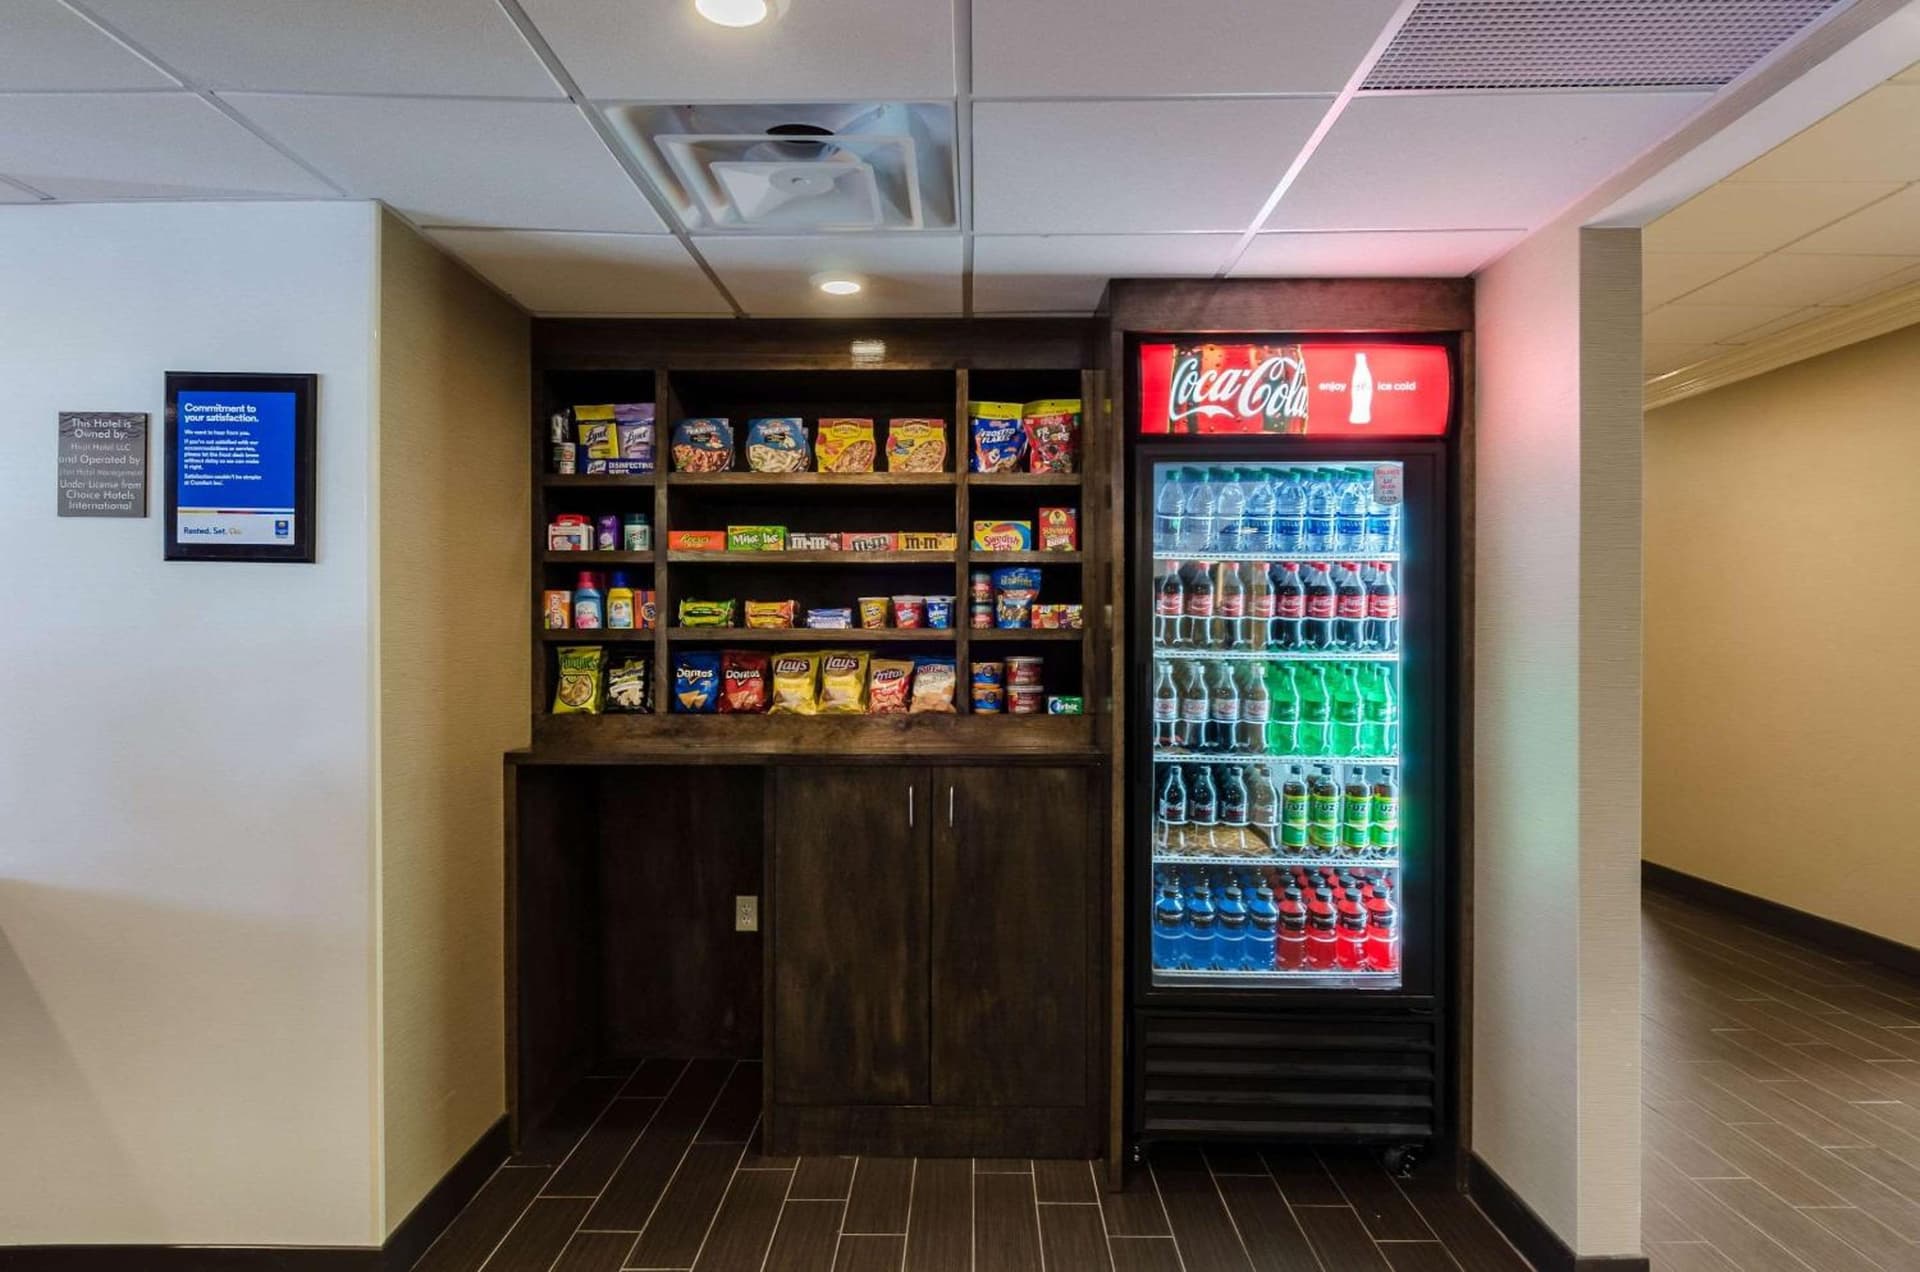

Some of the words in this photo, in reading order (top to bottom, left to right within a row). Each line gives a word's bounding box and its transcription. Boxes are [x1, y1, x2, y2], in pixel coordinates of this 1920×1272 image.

[1319, 382, 1346, 392] enjoy
[1377, 381, 1391, 391] ice
[1393, 381, 1416, 391] cold
[184, 403, 245, 413] Commitment
[247, 404, 257, 413] to
[72, 418, 92, 428] This
[94, 419, 121, 428] Hotel
[123, 420, 132, 428] is
[184, 414, 204, 423] your
[206, 413, 259, 422] satisfaction.
[74, 429, 111, 438] Owned
[113, 430, 128, 440] by:
[116, 443, 131, 451] LLC
[58, 456, 77, 464] and
[80, 455, 126, 465] Operated
[60, 480, 86, 489] Under
[88, 480, 119, 489] License
[121, 480, 142, 489] from
[66, 489, 101, 499] Choice
[103, 490, 136, 500] Hotels
[68, 501, 132, 510] International
[983, 535, 1020, 546] Swedish
[676, 667, 713, 679] Doritos
[725, 669, 760, 679] Doritos
